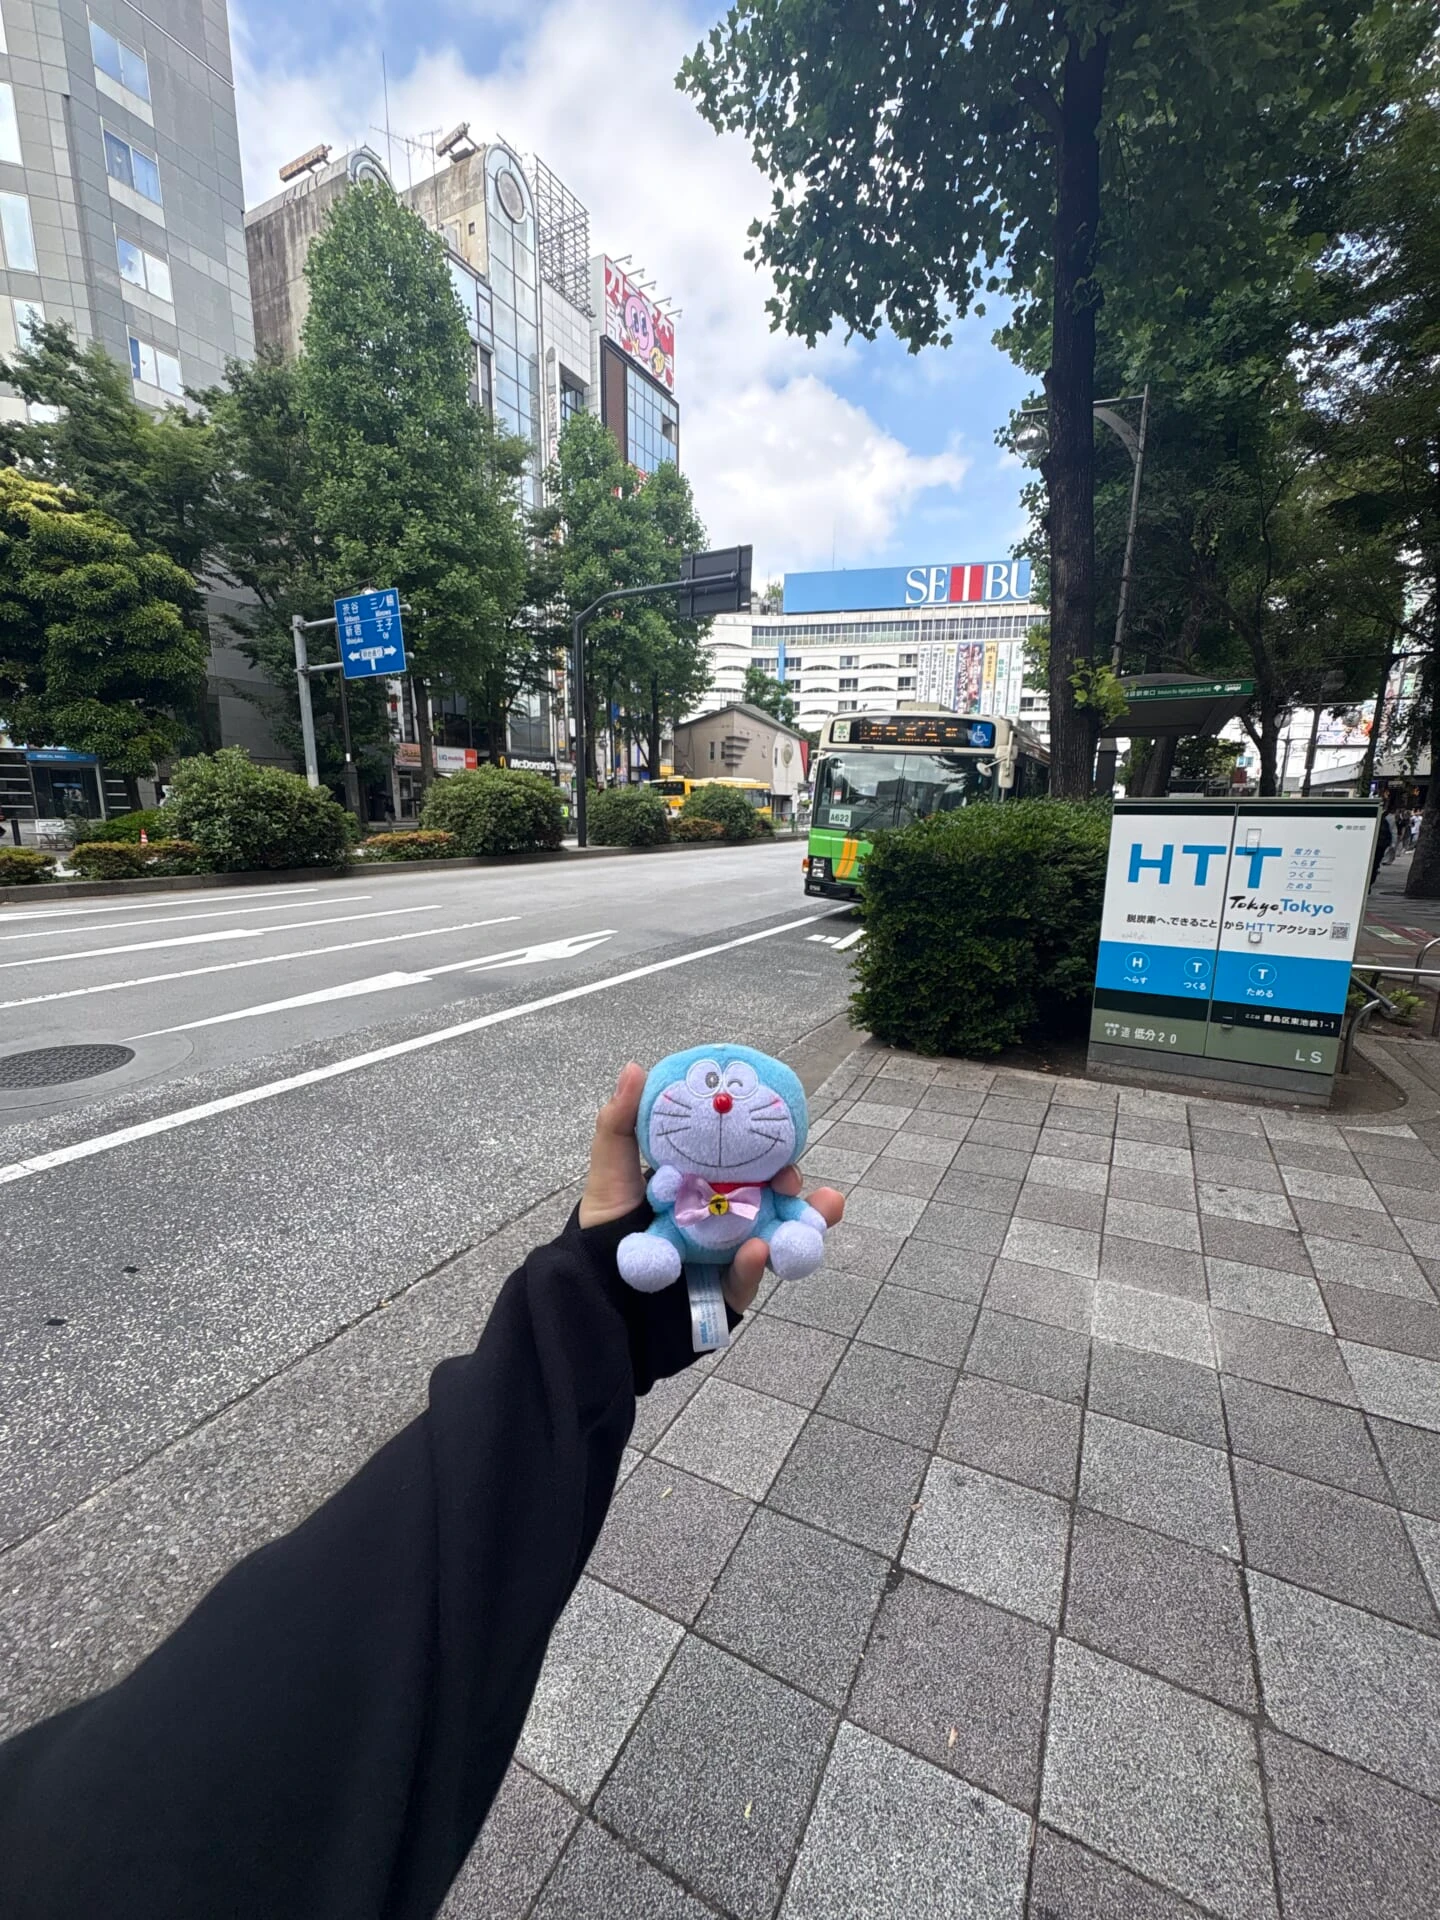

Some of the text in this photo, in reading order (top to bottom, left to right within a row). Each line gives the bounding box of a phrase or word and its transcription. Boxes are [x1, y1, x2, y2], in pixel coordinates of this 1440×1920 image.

[905, 562, 1034, 604] SEIBU
[345, 624, 361, 637] 新宿
[376, 618, 393, 632] 王子
[510, 758, 555, 771] McDonald's
[830, 813, 850, 824] A622
[1127, 843, 1283, 889] HTT
[1289, 871, 1315, 879] つくる
[1286, 882, 1313, 890] ためる
[1229, 895, 1334, 917] Tokyo Tokyo
[1132, 957, 1143, 968] H
[1193, 962, 1202, 973] T
[1258, 968, 1268, 979] T
[1124, 976, 1148, 985] へらす
[1183, 981, 1208, 991] つくる
[1246, 987, 1274, 998] ためる
